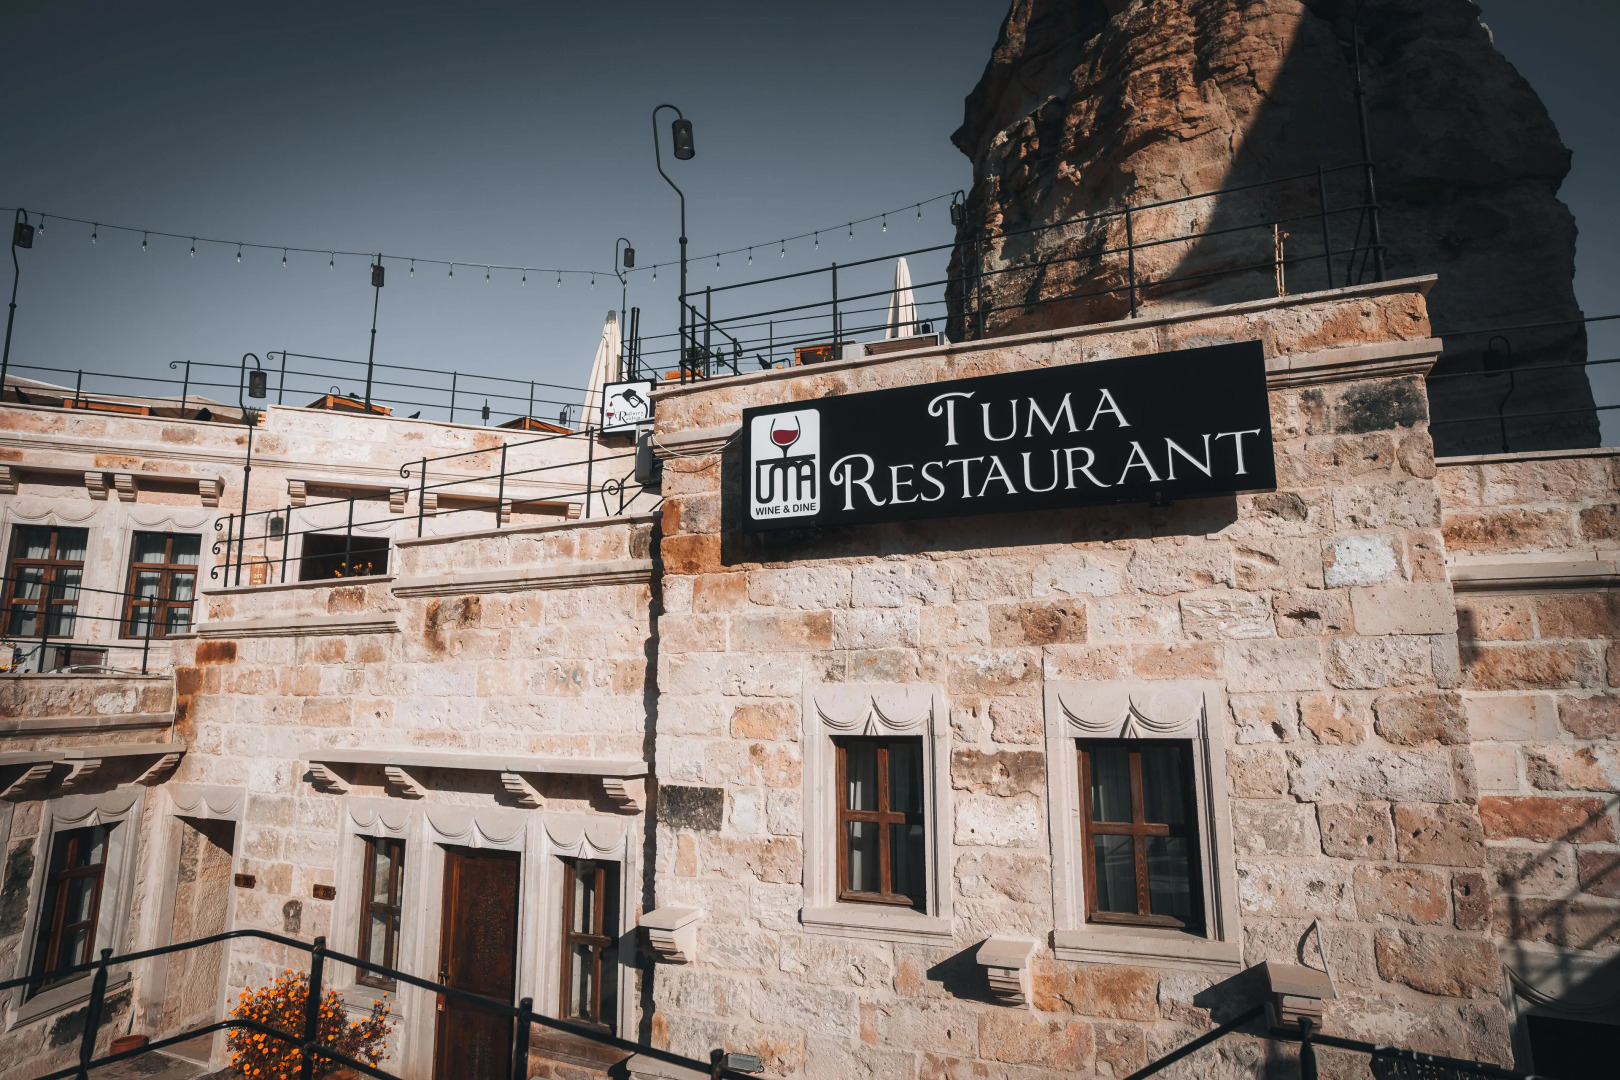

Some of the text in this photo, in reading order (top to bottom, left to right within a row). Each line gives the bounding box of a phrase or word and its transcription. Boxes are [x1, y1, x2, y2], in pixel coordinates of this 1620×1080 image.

[927, 388, 1131, 447] TUMA
[829, 428, 1261, 511] RESTAURANT
[755, 503, 816, 515] WINE & DINE
